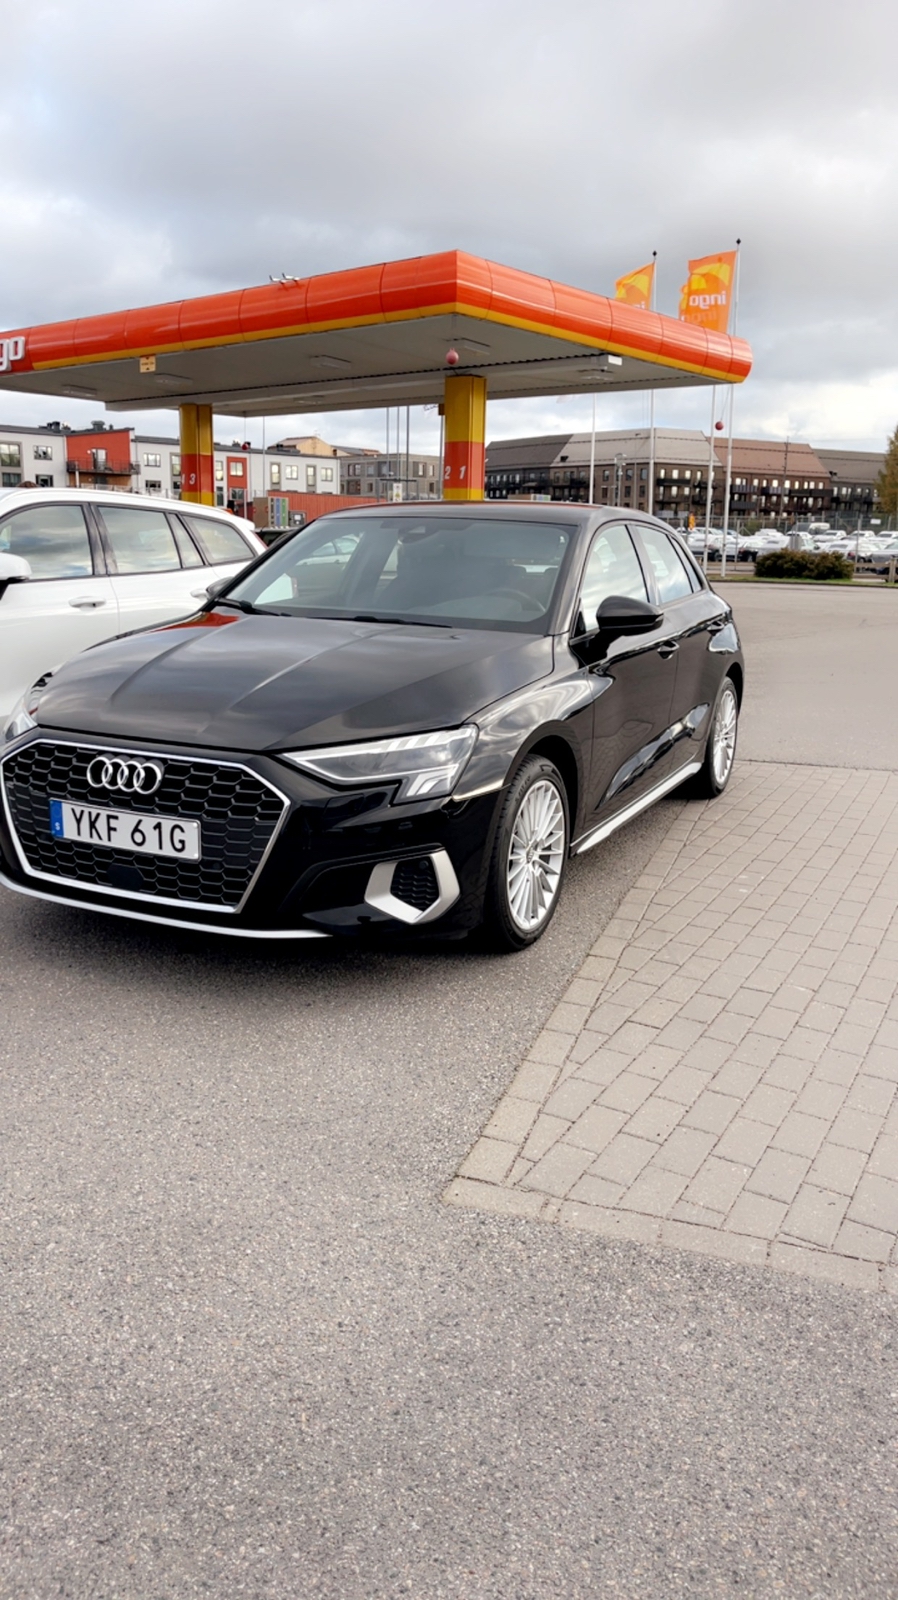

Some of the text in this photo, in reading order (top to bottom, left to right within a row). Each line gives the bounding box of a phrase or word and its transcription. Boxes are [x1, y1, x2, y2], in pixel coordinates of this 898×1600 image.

[189, 473, 196, 485] 3
[444, 465, 467, 480] 2 1
[71, 807, 186, 853] YKF 61G
